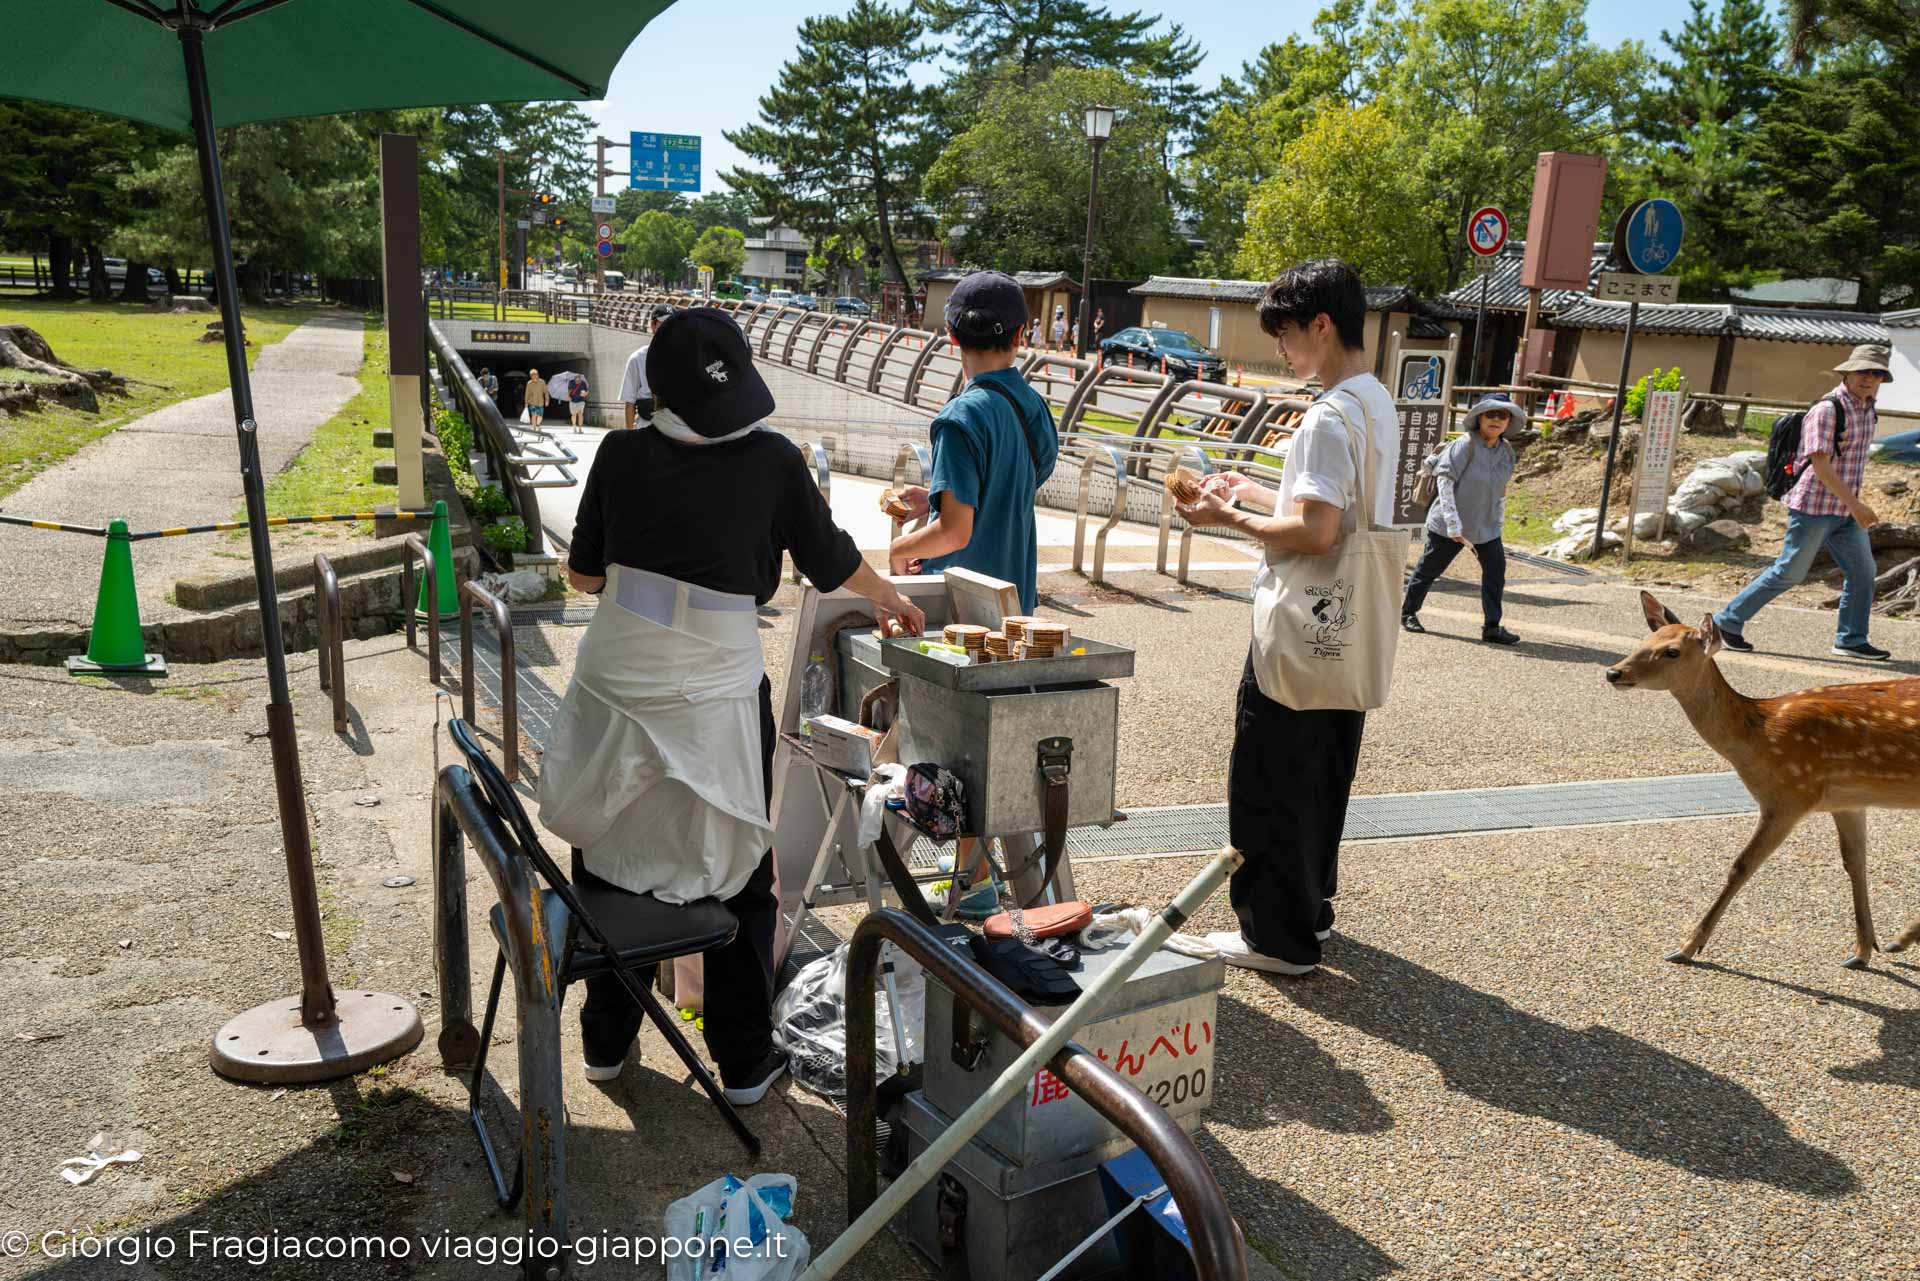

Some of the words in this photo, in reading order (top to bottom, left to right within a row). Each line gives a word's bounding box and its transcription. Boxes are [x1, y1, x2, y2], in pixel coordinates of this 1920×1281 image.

[1607, 280, 1672, 297] ここまで
[1400, 411, 1422, 518] 自転車を降りて
[1313, 647, 1342, 657] Tigers
